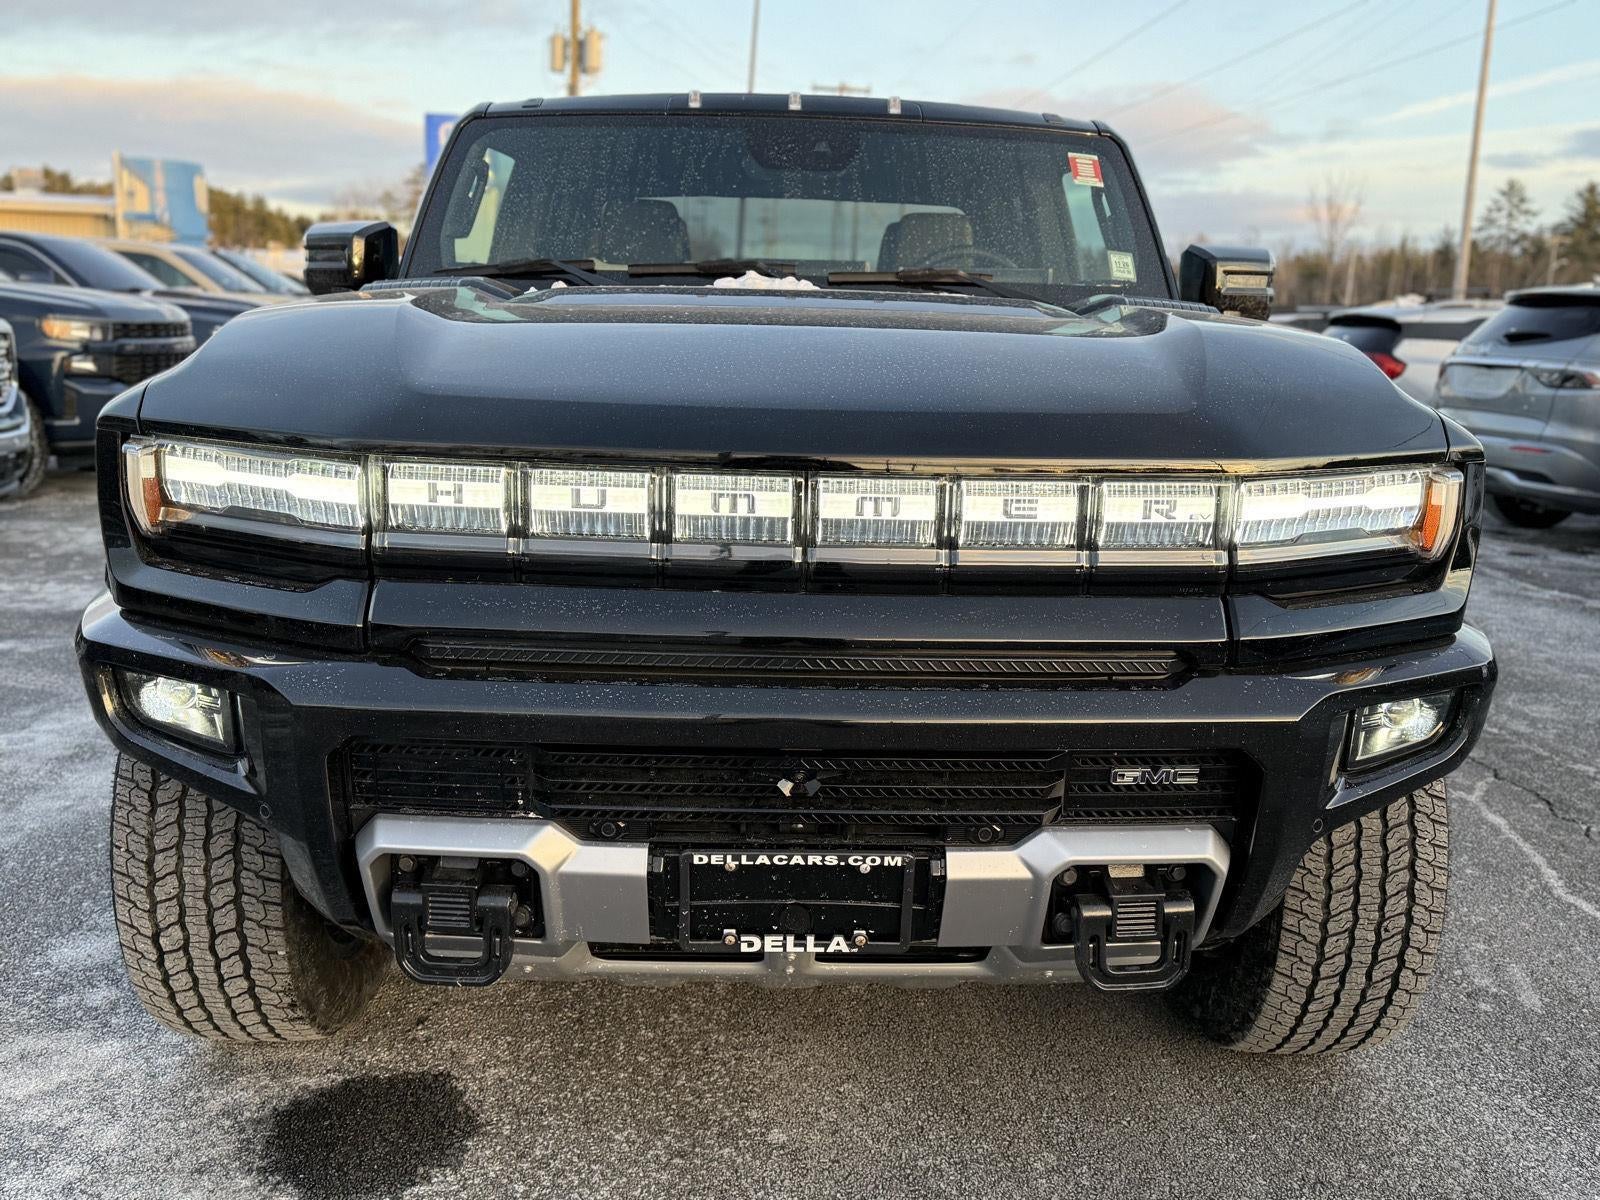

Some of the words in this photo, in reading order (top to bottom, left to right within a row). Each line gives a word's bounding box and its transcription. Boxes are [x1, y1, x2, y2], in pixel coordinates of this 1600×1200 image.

[1111, 767, 1200, 785] GMC
[692, 854, 903, 867] DELLACARS.COM
[740, 935, 850, 953] DELLA
